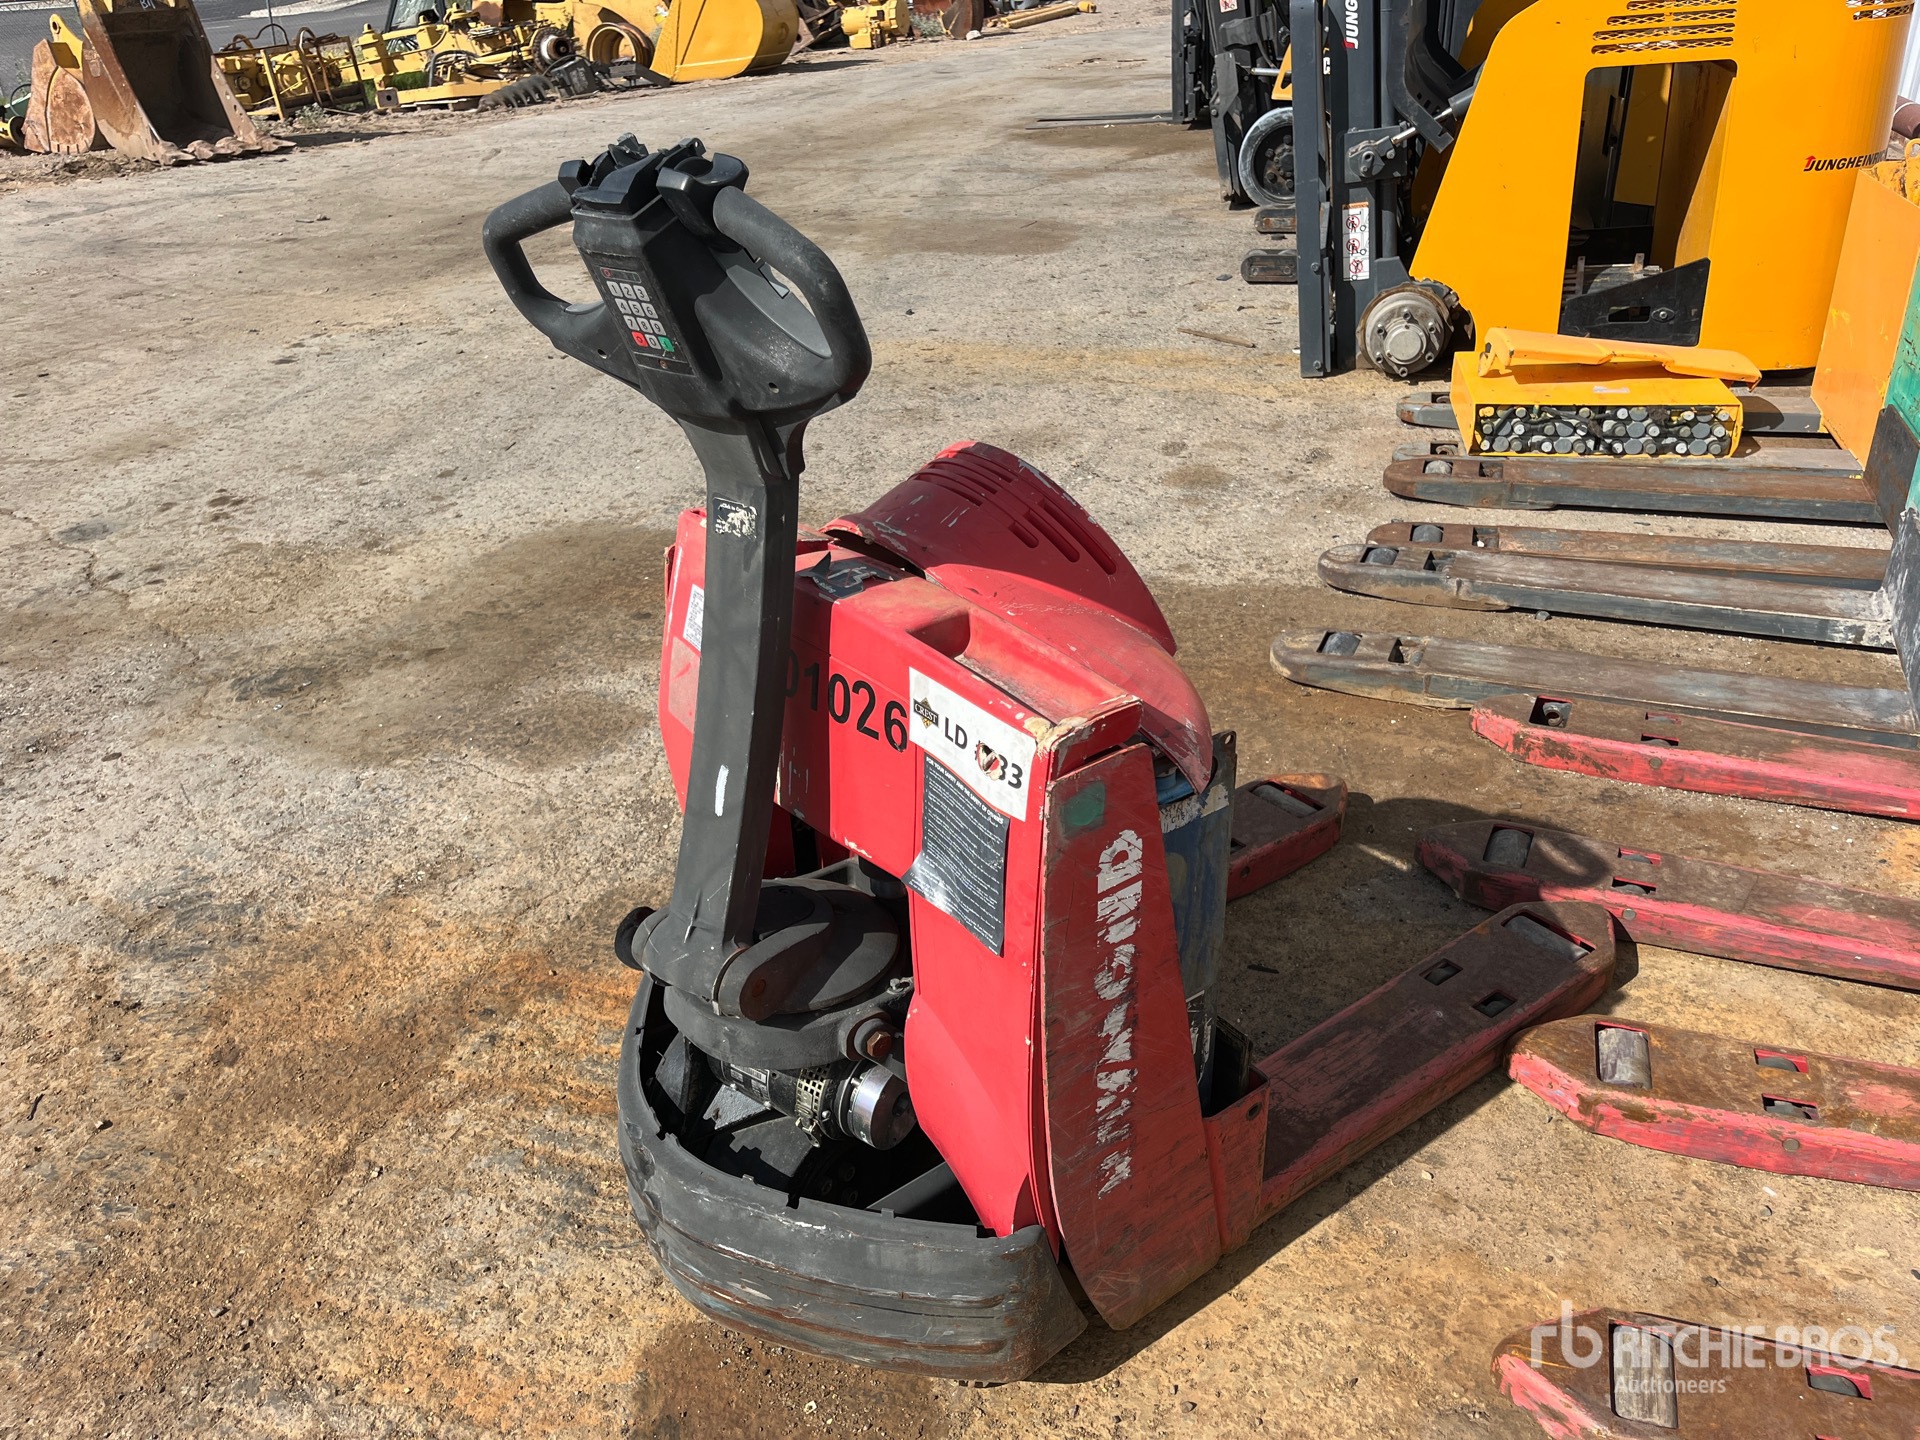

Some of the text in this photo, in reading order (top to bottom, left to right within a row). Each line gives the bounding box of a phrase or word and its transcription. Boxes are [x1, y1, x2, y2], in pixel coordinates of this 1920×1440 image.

[914, 703, 938, 723] CREST
[944, 716, 1023, 789] LD 33
